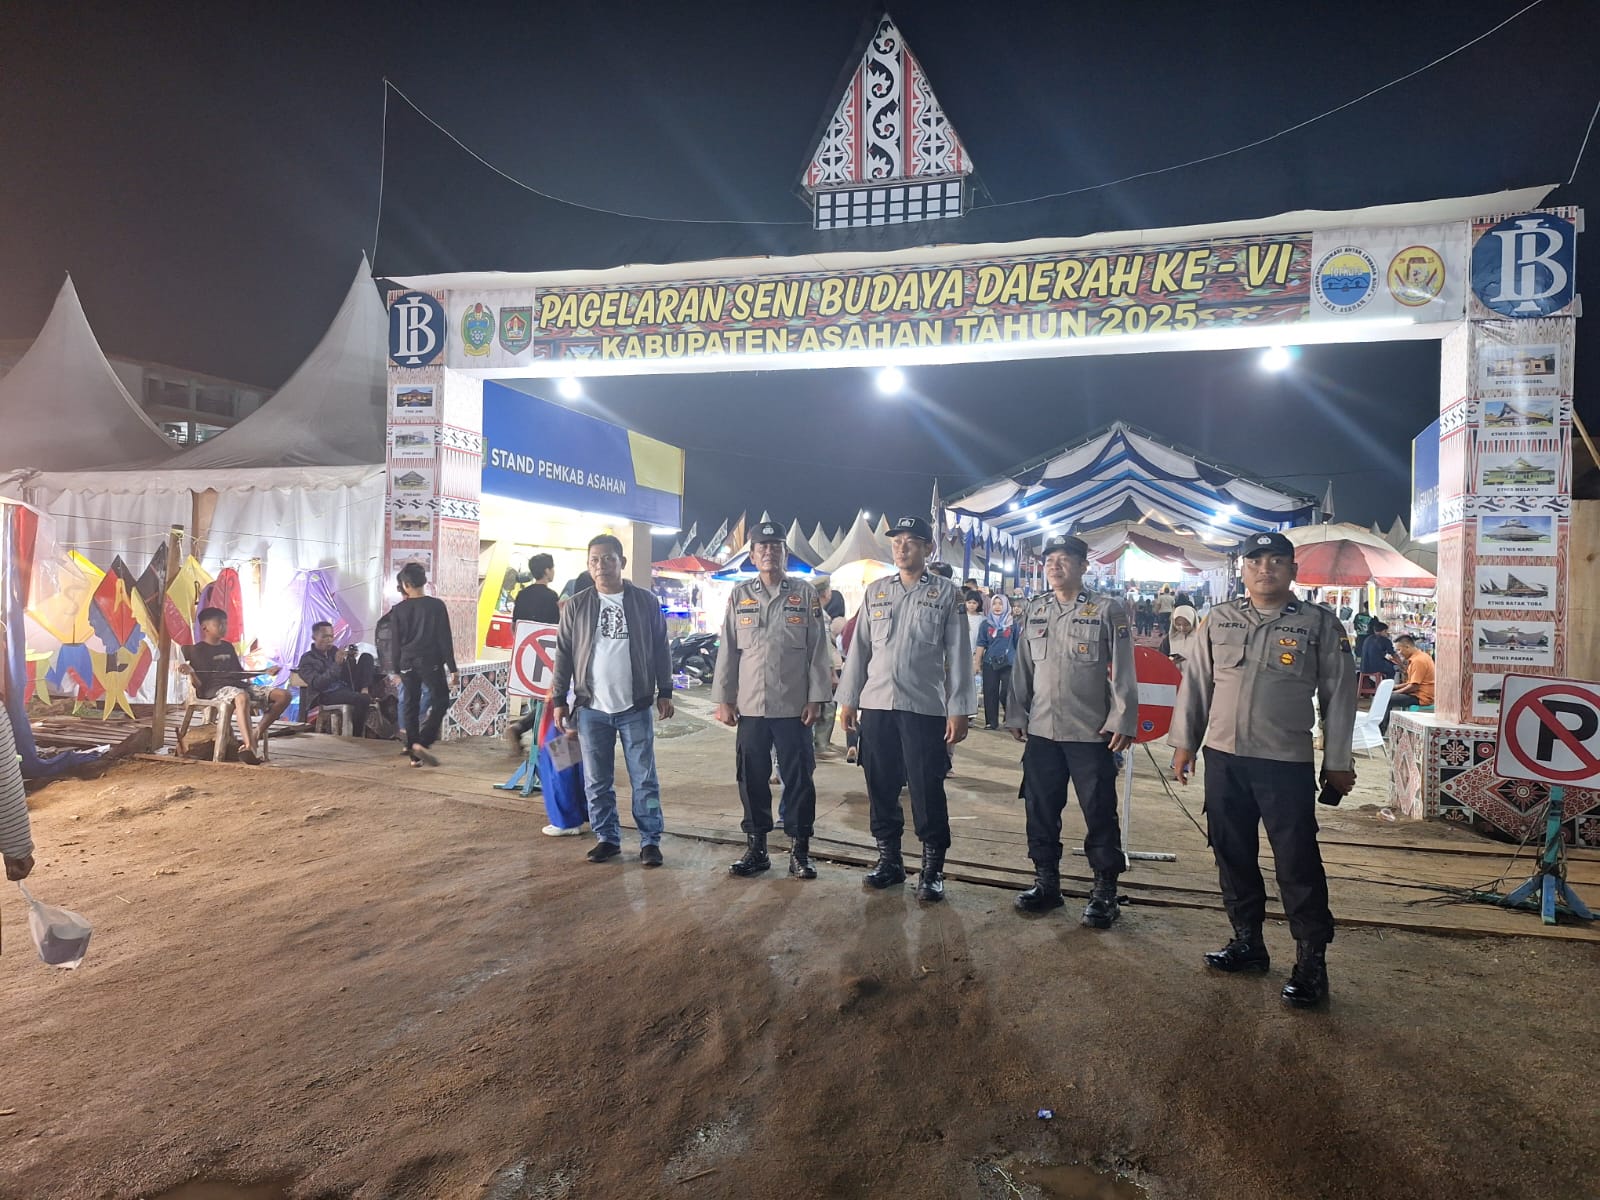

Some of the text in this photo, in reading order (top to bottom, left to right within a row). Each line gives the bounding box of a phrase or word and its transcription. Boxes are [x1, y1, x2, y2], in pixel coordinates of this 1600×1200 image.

[539, 285, 727, 329] PAGELARAN
[731, 280, 812, 321] SENI
[818, 268, 964, 317] BUDAYA
[975, 254, 1145, 305] DAERAH
[602, 302, 1198, 361] KABUPATEN ASAHAN TAHUN 2025
[491, 448, 627, 495] STAND PEMKAB ASAHAN
[917, 600, 944, 610] POLRI
[1072, 618, 1100, 626] POLRI
[1274, 626, 1308, 636] POLRI
[1536, 699, 1599, 762] P
